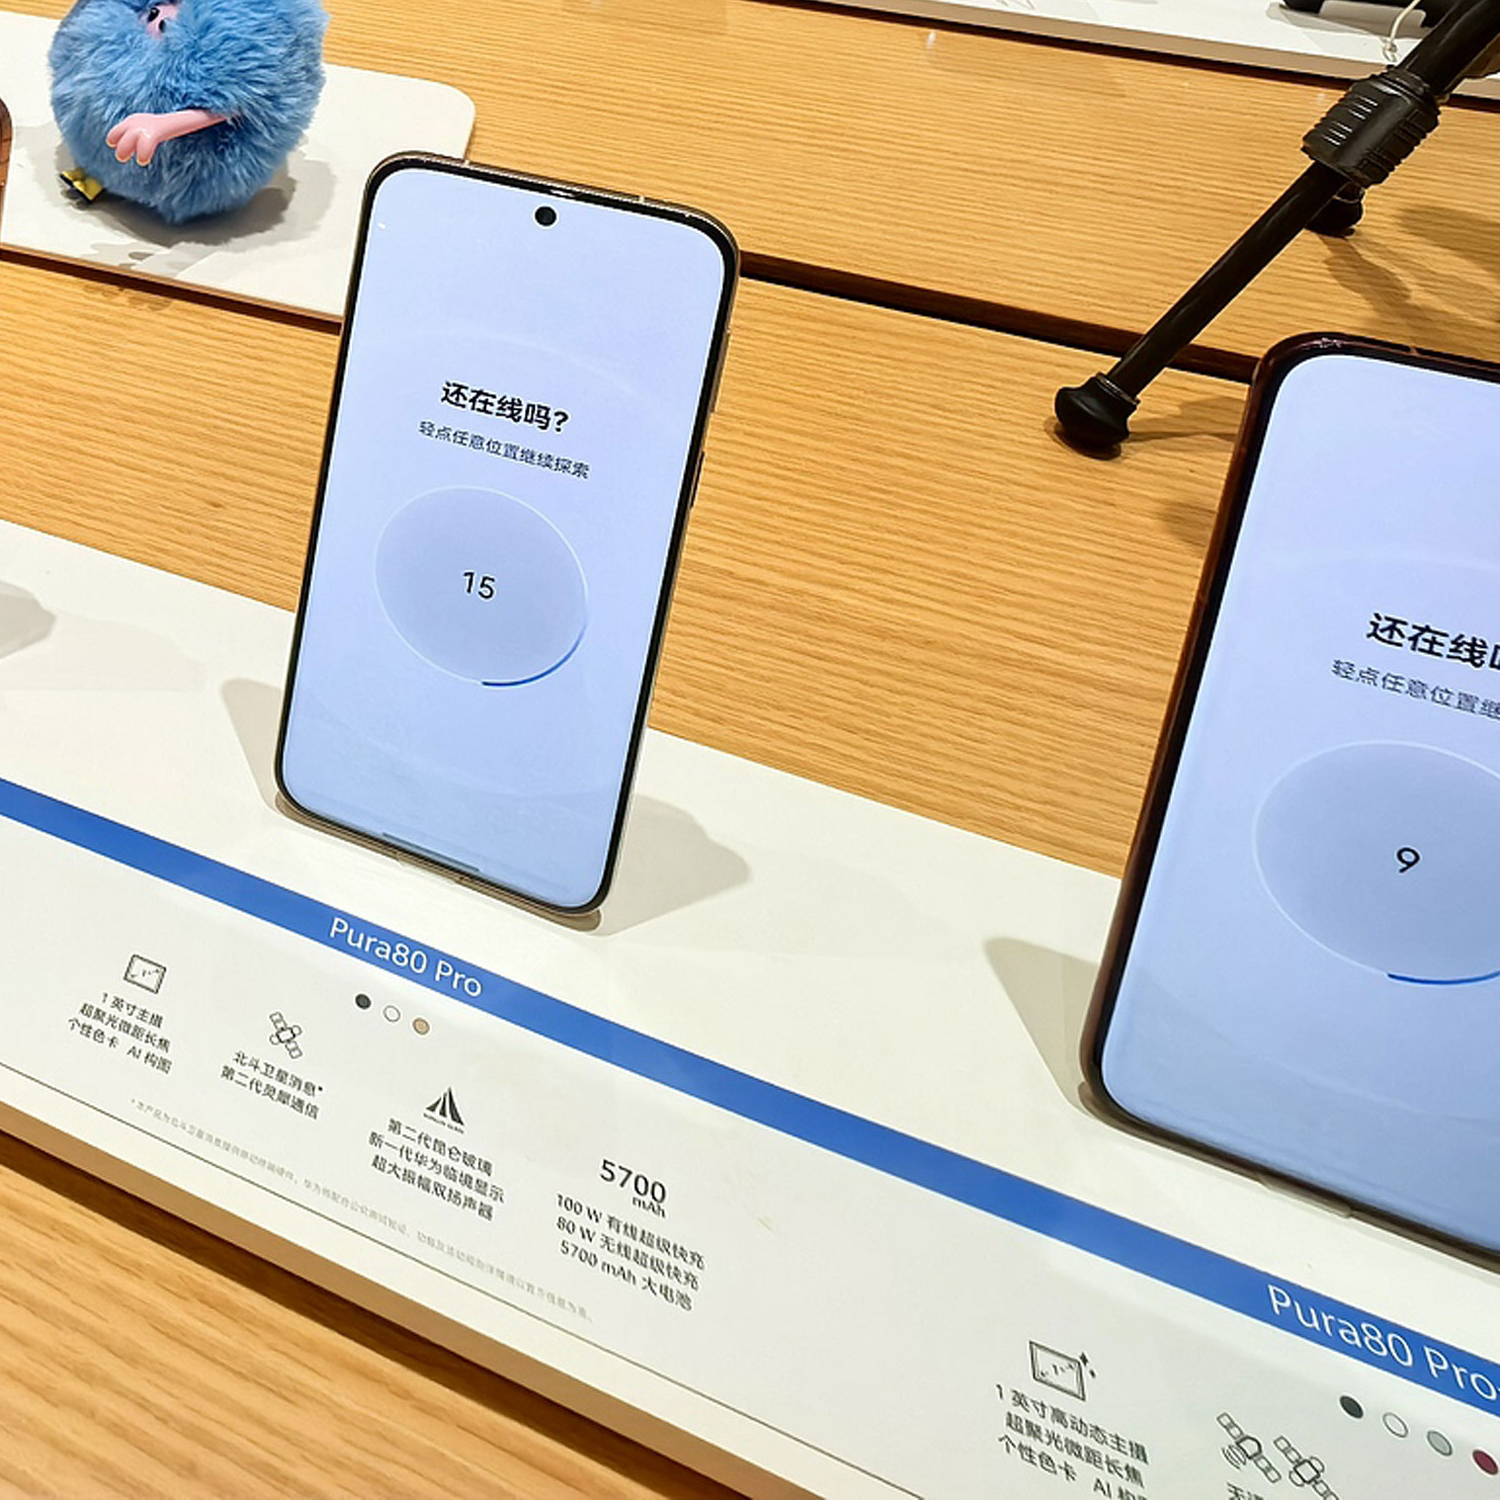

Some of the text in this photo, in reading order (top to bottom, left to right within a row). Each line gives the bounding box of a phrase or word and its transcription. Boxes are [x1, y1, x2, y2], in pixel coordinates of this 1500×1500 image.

[440, 379, 570, 433] 还在线吗？
[418, 419, 590, 480] 轻点任意位置继续探索
[463, 571, 496, 600] 15
[1396, 847, 1421, 873] 9
[329, 916, 483, 997] Pura80 Pro
[78, 1002, 172, 1054] 超聚光微距长焦
[109, 995, 164, 1029] 英寸主摄
[67, 1017, 173, 1075] 个性色卡 AI 构图
[367, 1130, 506, 1204] 新一代华为临境显示
[387, 1117, 494, 1178] 第二代昆仑玻璃
[370, 1153, 494, 1222] 超大振幅双扬声器
[600, 1158, 668, 1204] 5700
[632, 1196, 667, 1219] mAh
[556, 1193, 706, 1271] 100 W 有线超级快充
[556, 1216, 700, 1291] 80 W 无线超级快充
[560, 1240, 693, 1312] 5700 mAh 大电池
[1267, 1283, 1414, 1367] Pura80
[995, 1383, 1149, 1466] 1 英寸高动态主摄
[1005, 1411, 1146, 1489] 超聚光微距长焦
[998, 1433, 1077, 1482] 个性色卡
[1092, 1477, 1112, 1499] AI
